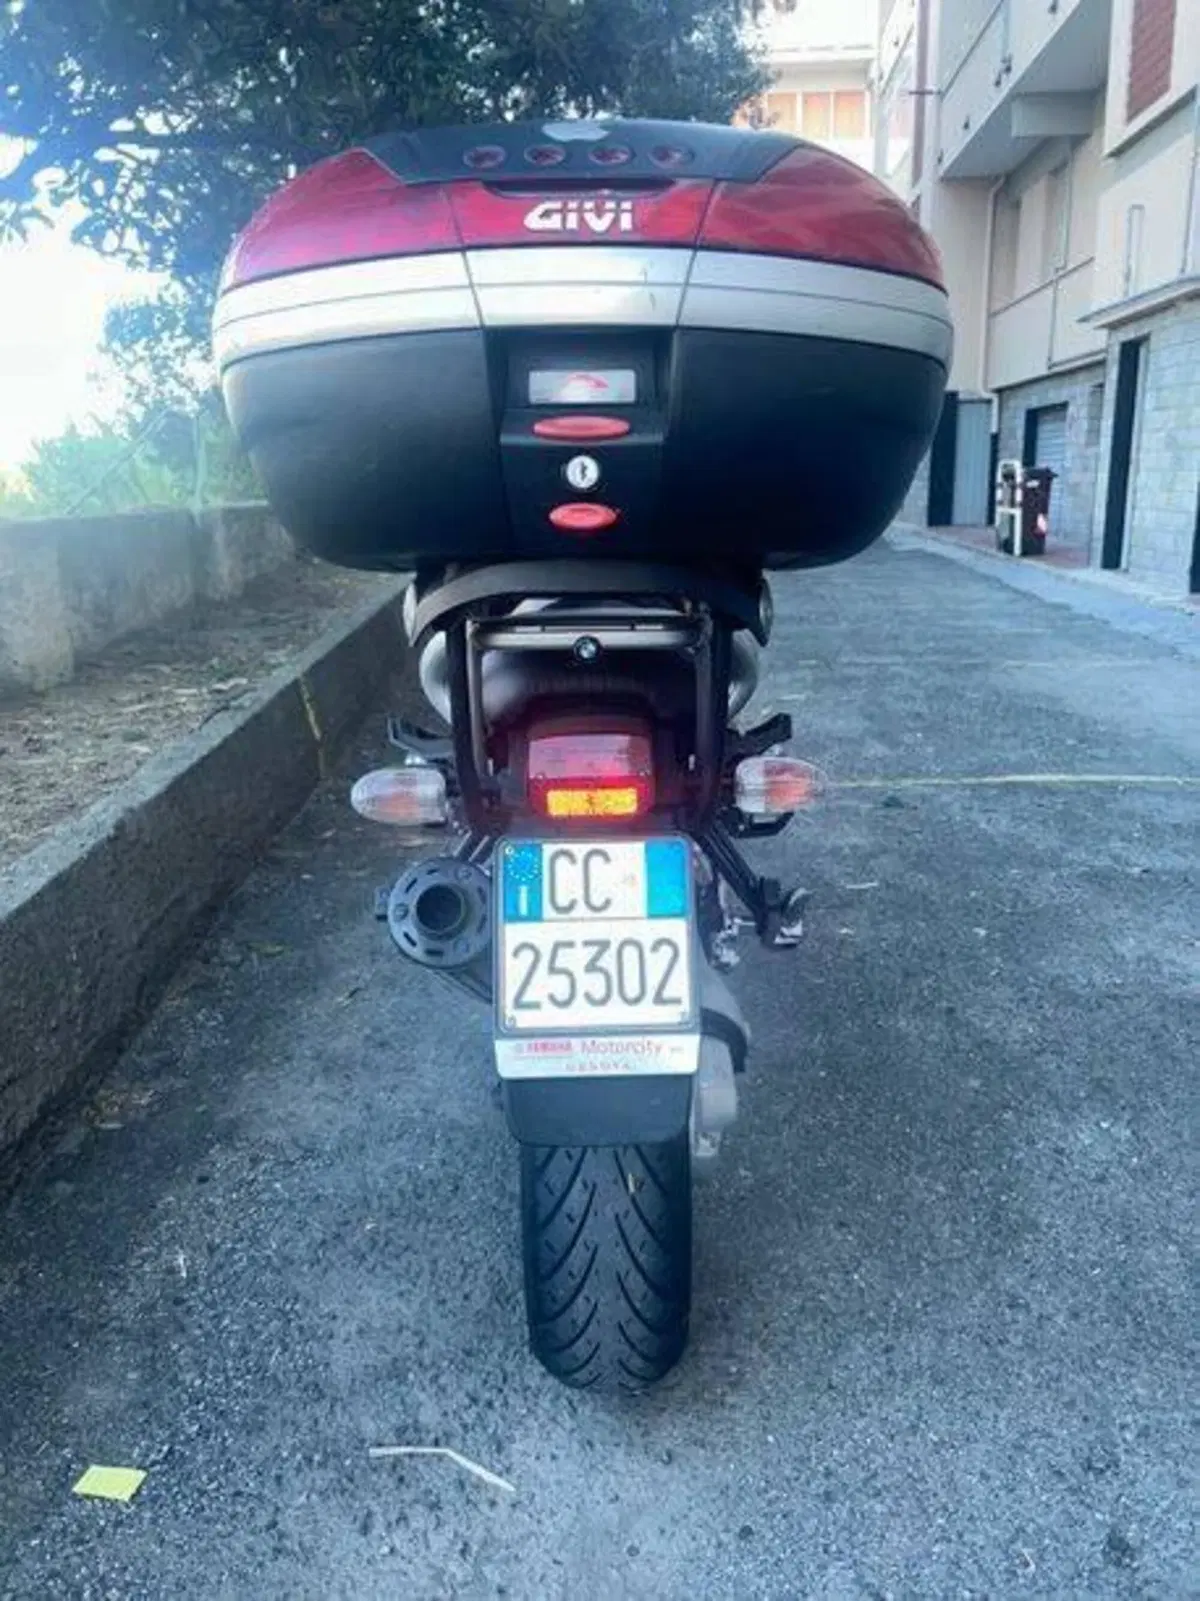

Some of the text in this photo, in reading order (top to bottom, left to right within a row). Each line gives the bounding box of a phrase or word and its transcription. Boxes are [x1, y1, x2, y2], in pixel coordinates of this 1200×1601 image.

[549, 848, 612, 914] CC
[511, 937, 683, 1010] 25302
[581, 1038, 662, 1056] Motorcity
